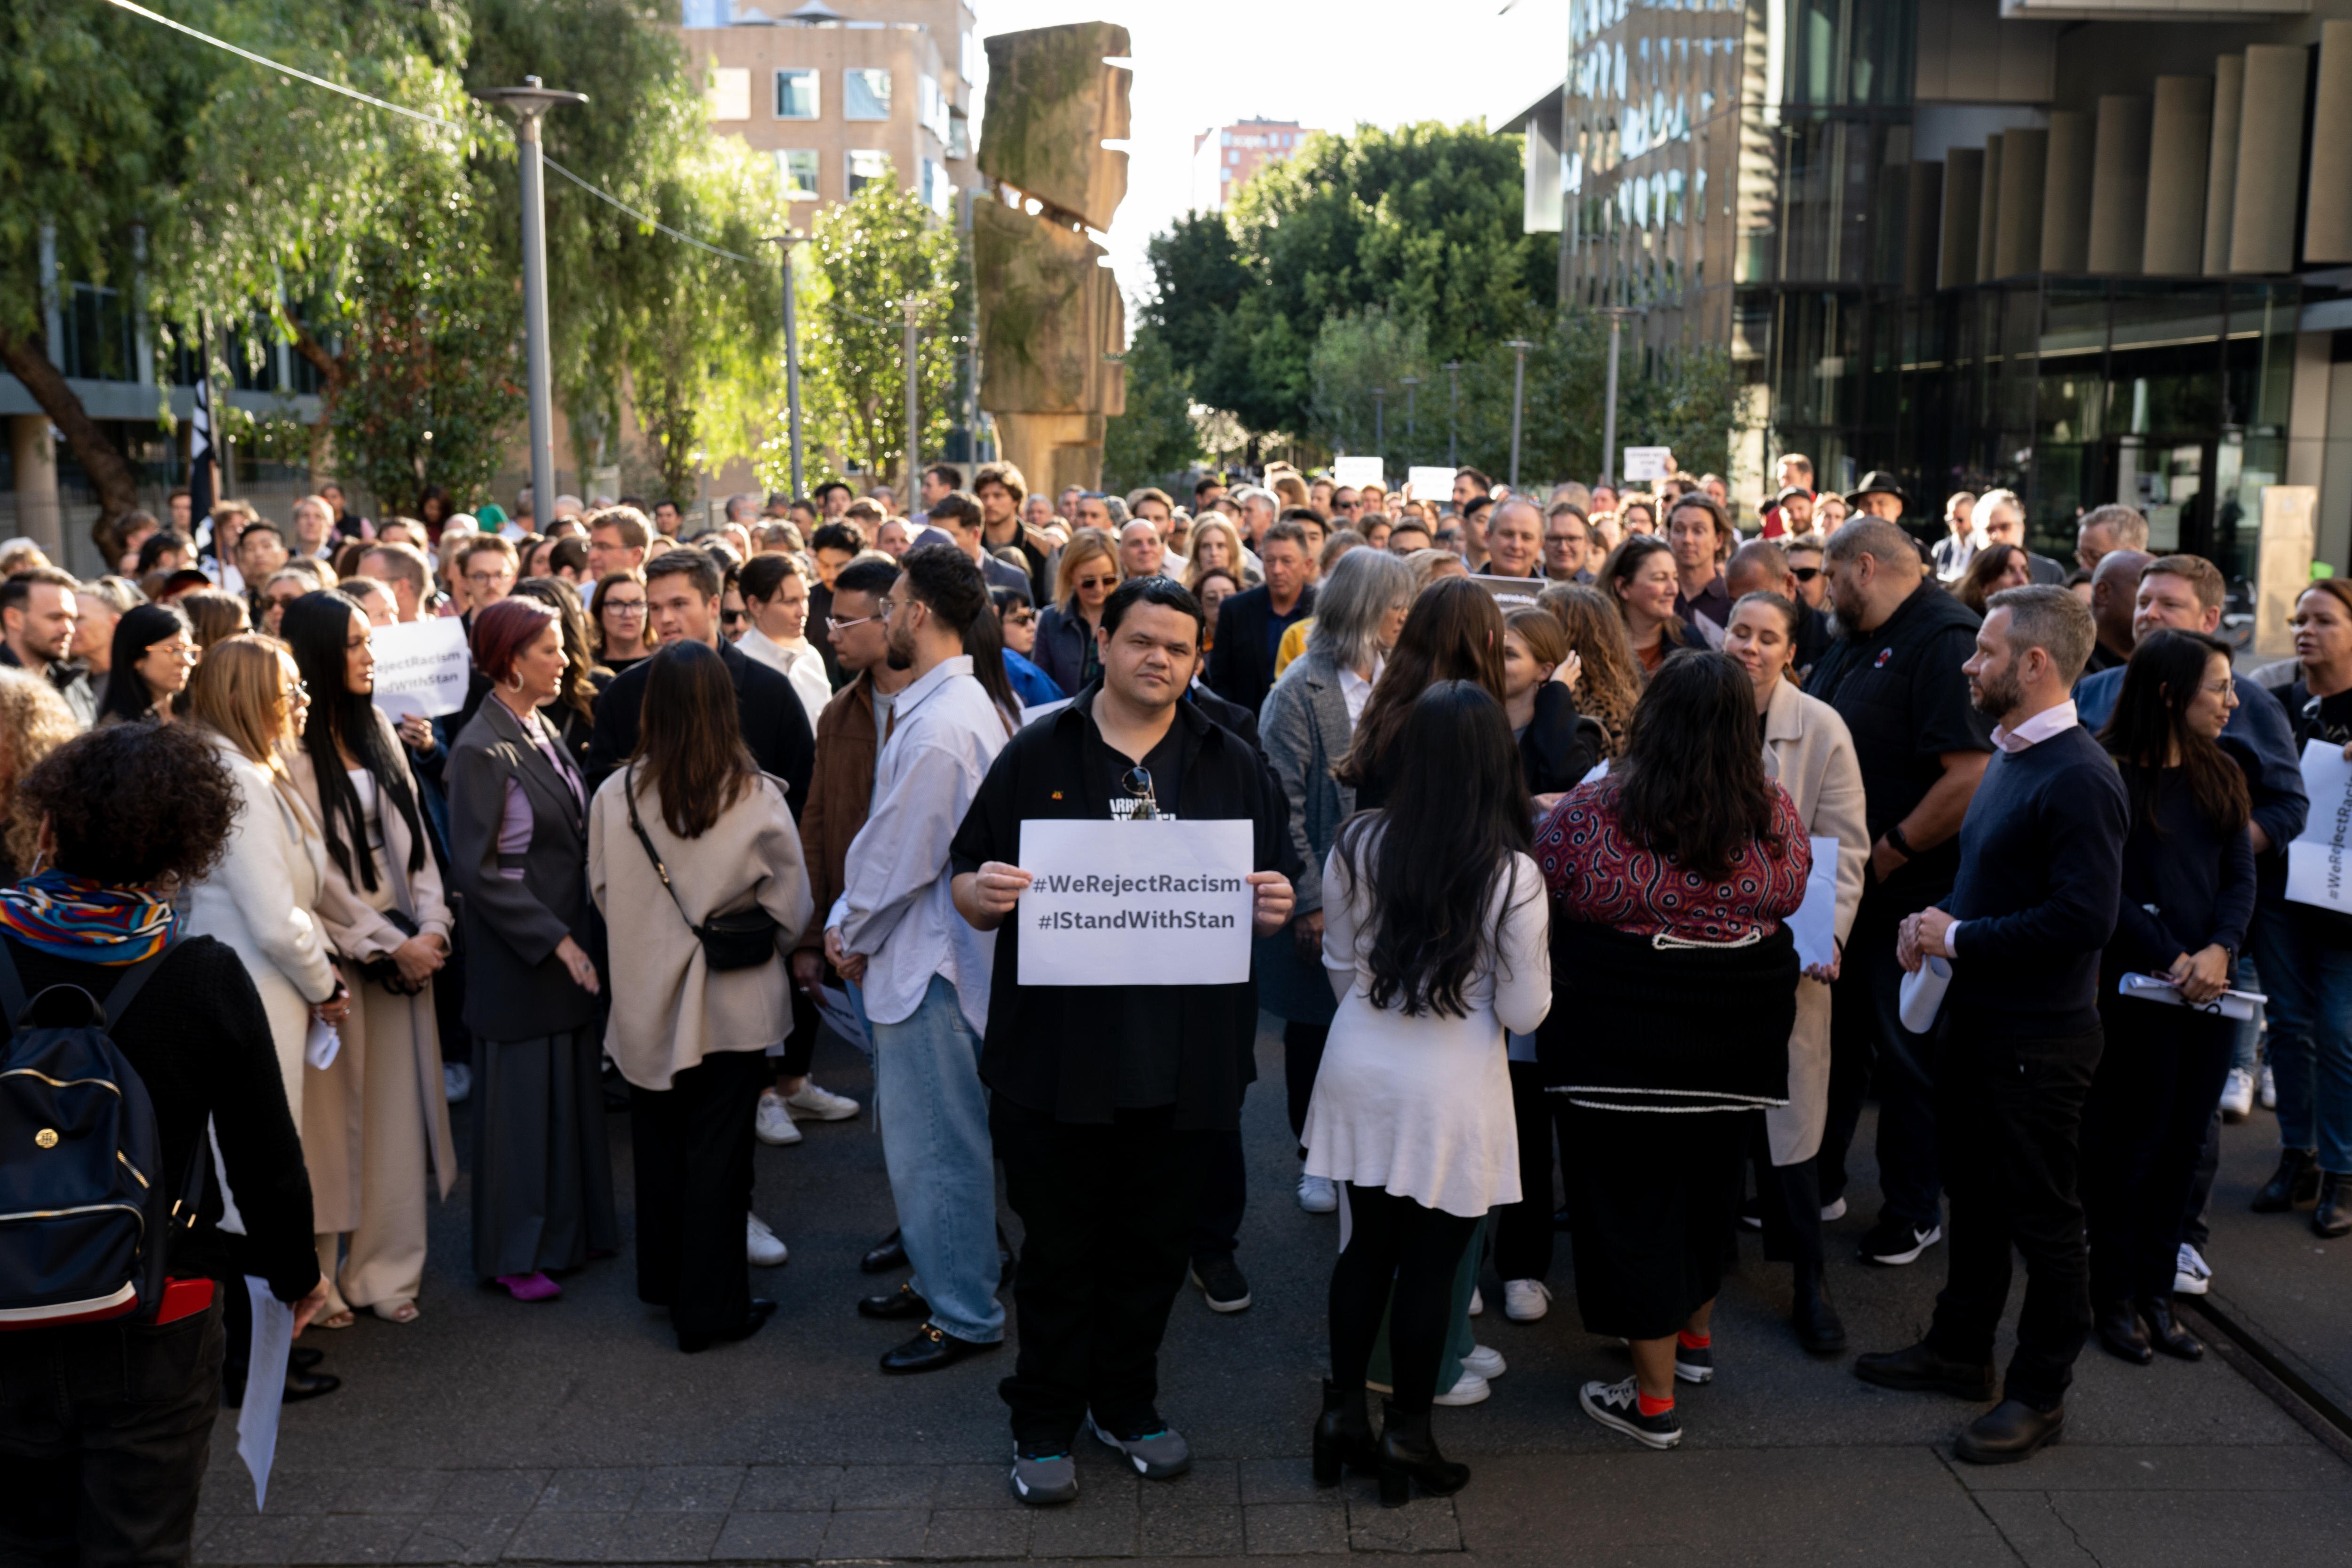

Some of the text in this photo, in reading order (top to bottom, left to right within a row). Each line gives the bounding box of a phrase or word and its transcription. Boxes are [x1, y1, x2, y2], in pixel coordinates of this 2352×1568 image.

[377, 651, 461, 674] ejectRacism
[1033, 874, 1240, 896] #WeRejectRacism
[1038, 910, 1234, 930] #IStandWithStan
